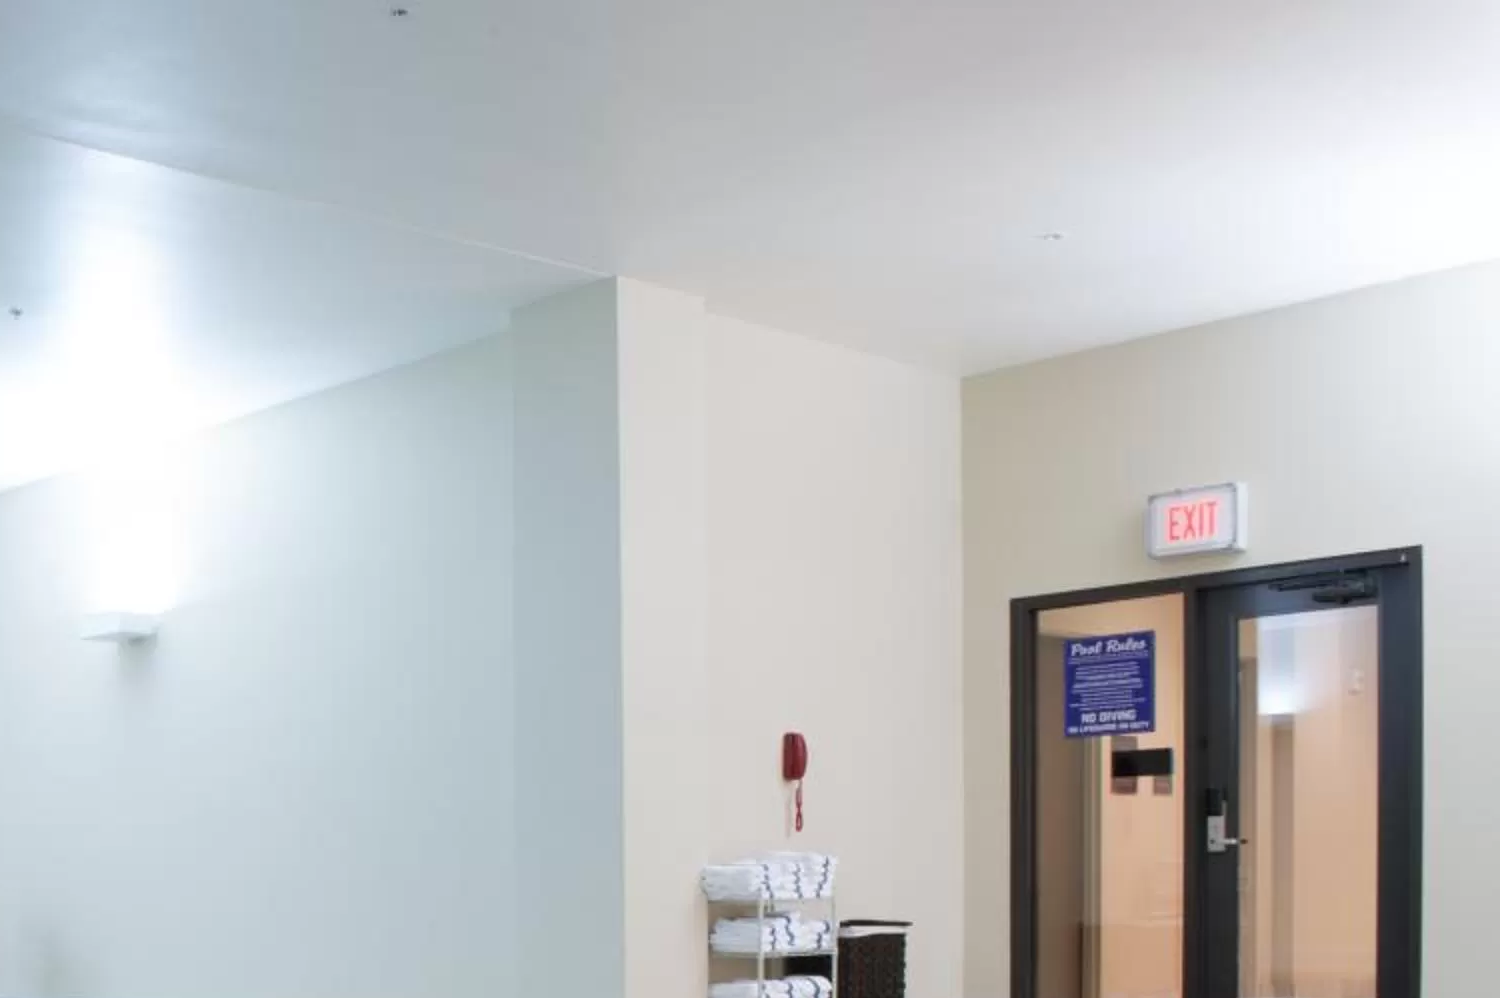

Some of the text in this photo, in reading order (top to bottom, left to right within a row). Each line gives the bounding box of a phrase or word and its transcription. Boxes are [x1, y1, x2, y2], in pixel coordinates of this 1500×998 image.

[1167, 500, 1217, 541] EXIT
[1070, 637, 1146, 656] Pool Rules
